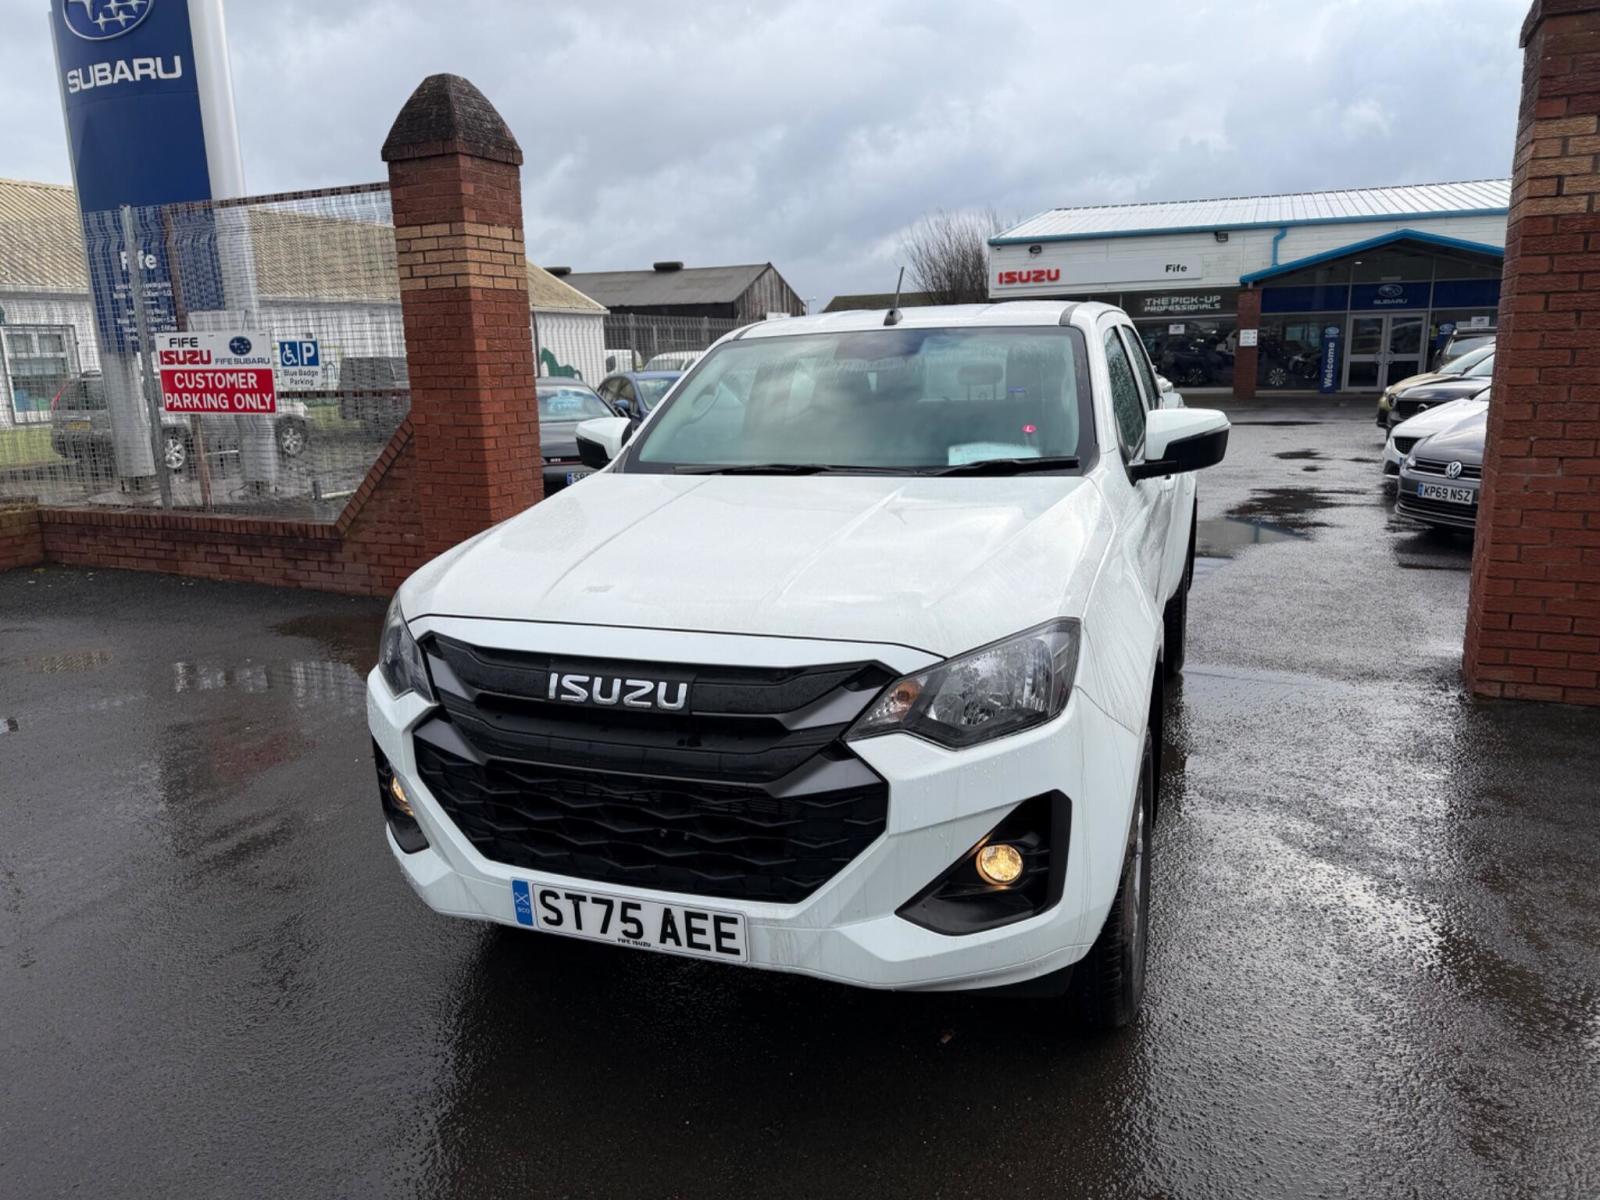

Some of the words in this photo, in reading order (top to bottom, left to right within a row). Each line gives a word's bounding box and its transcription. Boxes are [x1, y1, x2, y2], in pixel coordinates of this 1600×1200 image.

[67, 55, 182, 93] SUBARU
[998, 269, 1060, 284] ISUZU
[1165, 264, 1187, 273] Fife
[1145, 298, 1169, 306] THE
[1171, 295, 1221, 304] PICK-UP
[169, 337, 199, 348] FIFE
[160, 350, 212, 365] ISUZU
[301, 342, 315, 365] P
[299, 369, 319, 377] Badge
[1323, 342, 1335, 388] Welcome
[174, 373, 258, 389] CUSTOMER
[290, 378, 314, 386] Parking
[165, 393, 229, 409] PARKING
[234, 393, 272, 410] ONLY
[1424, 485, 1449, 499] KP69
[1450, 488, 1471, 502] NSZ
[548, 672, 687, 711] ISUZU
[539, 889, 644, 940] ST75
[659, 907, 741, 956] AEE
